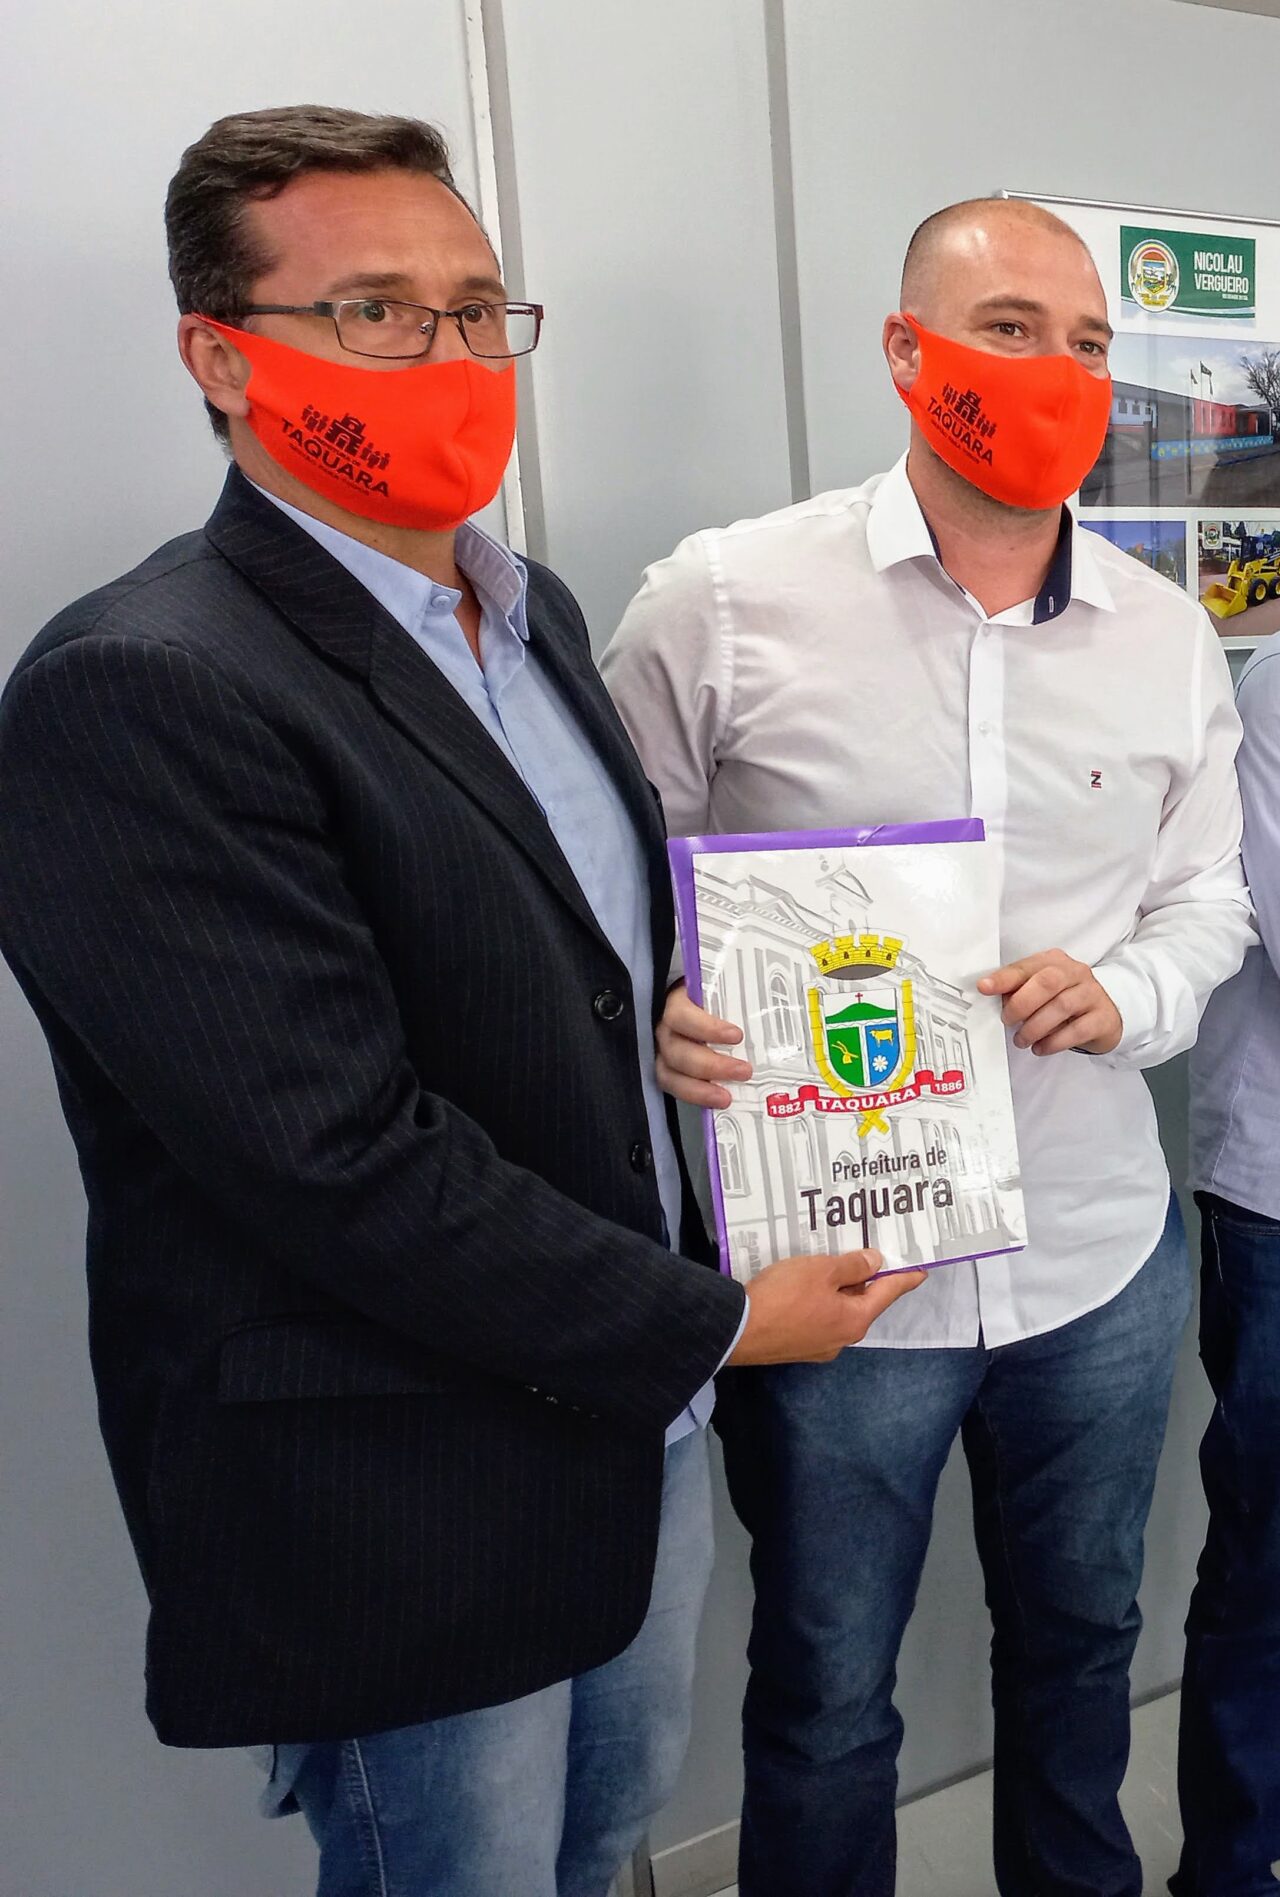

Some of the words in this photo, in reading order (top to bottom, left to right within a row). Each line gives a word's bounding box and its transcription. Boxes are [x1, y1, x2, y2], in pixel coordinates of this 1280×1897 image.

[1193, 251, 1243, 274] NICOLAU
[1194, 273, 1249, 294] VERGUEIRO
[928, 396, 993, 466] TAQUARA
[281, 417, 389, 497] TAQUARA
[770, 1102, 802, 1115] 1882
[820, 1088, 917, 1110] TAQUARA
[933, 1080, 962, 1093] 1886
[832, 1153, 921, 1182] Prefeitura
[926, 1146, 947, 1167] de
[801, 1177, 954, 1249] Taquara
